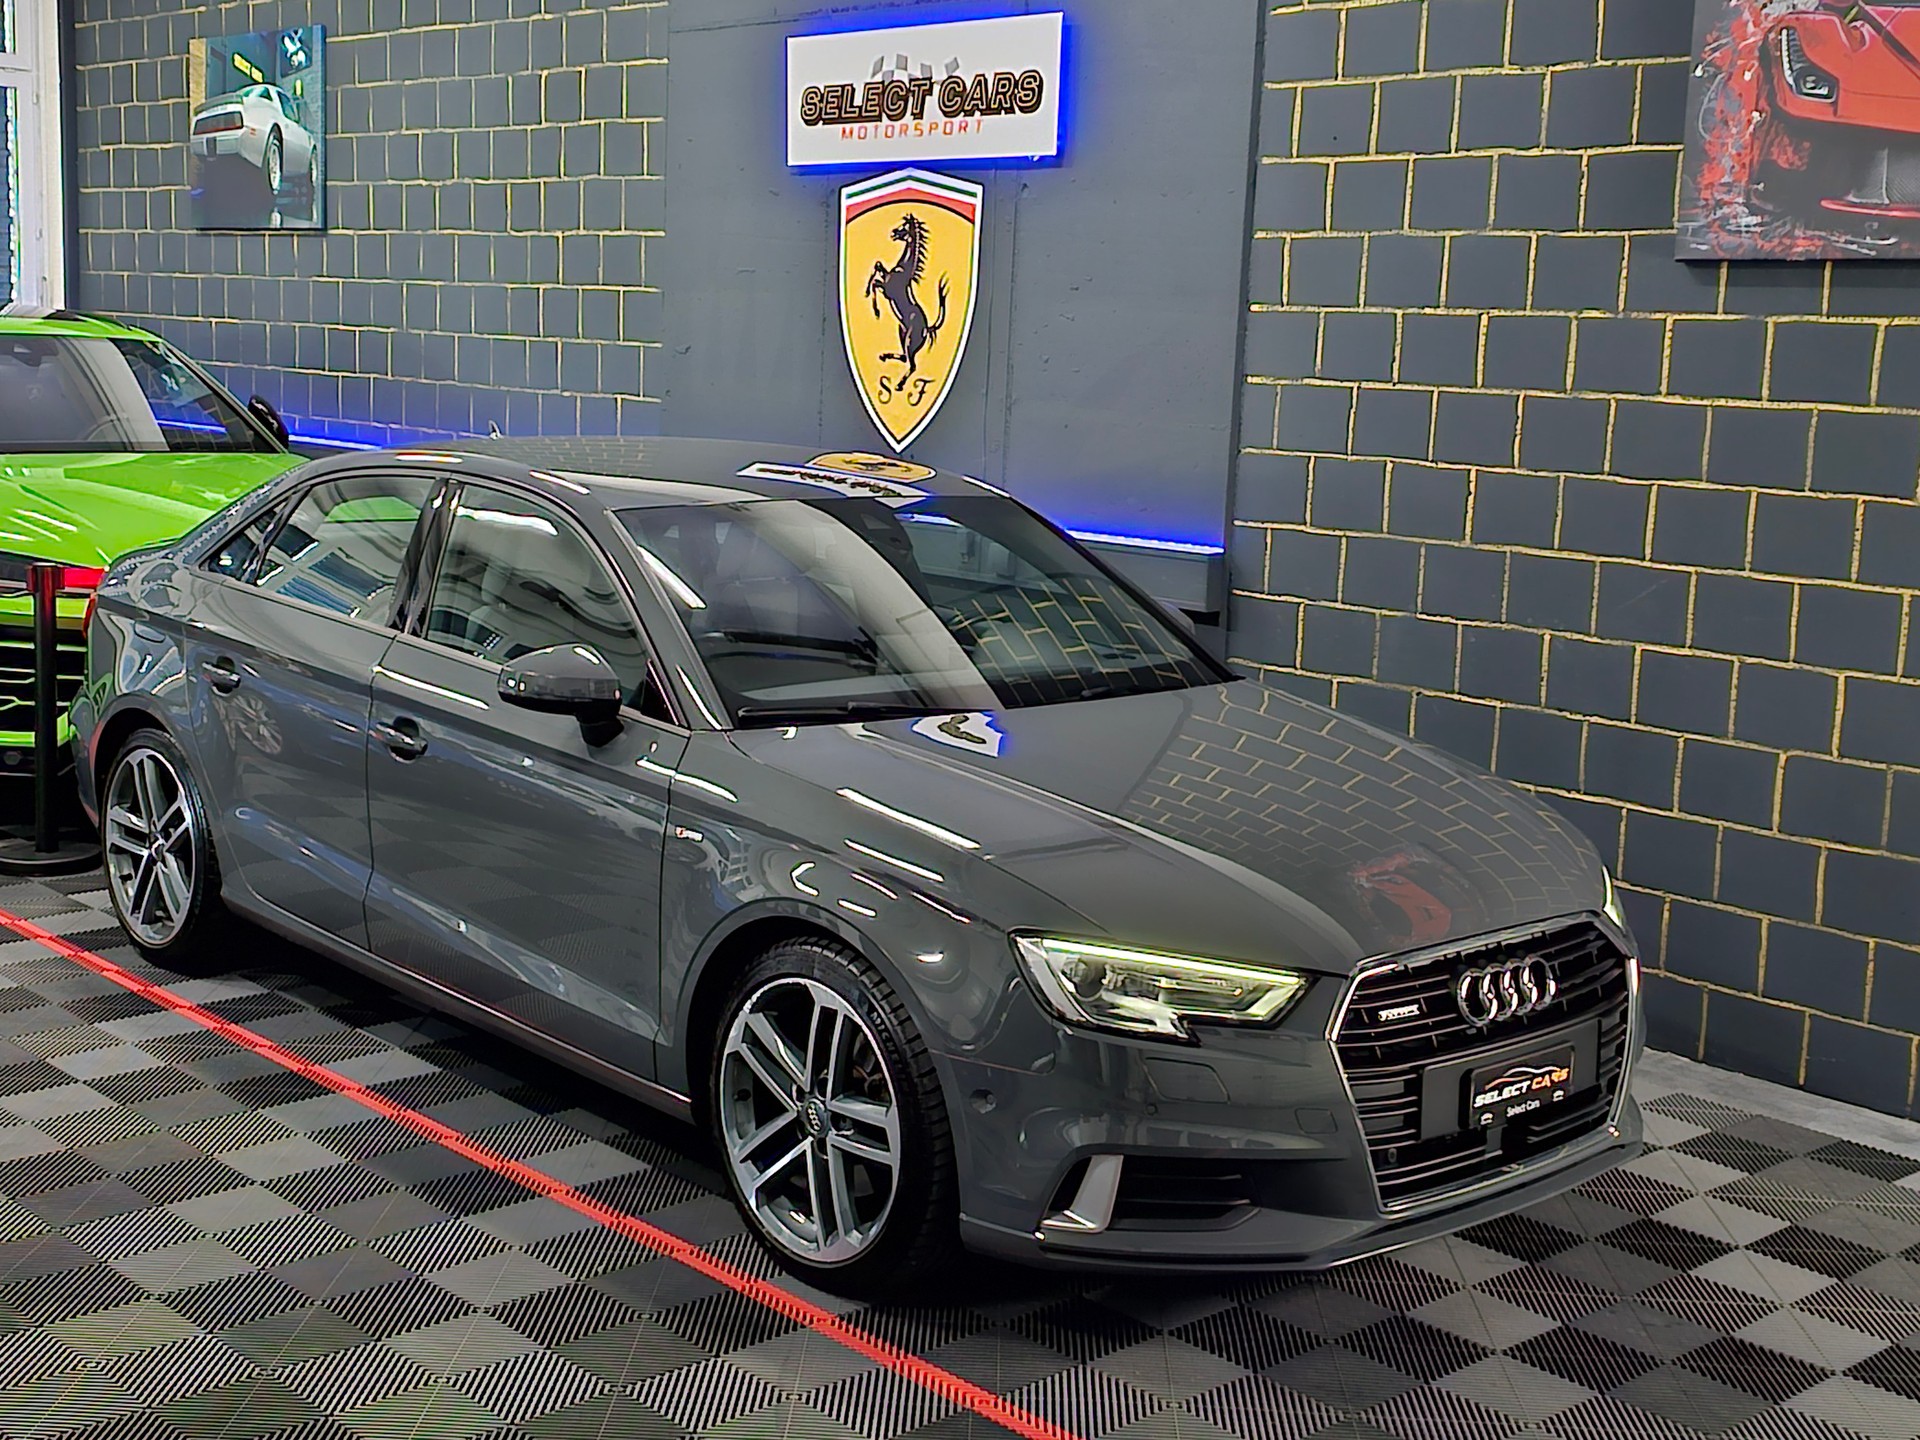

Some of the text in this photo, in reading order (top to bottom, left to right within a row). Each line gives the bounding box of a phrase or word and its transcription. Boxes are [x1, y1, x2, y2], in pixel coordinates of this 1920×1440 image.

[801, 69, 1044, 126] SELECT CARS
[840, 118, 984, 141] MOTORSPORT
[877, 375, 892, 404] S
[1473, 1067, 1570, 1108] SELECT CARS
